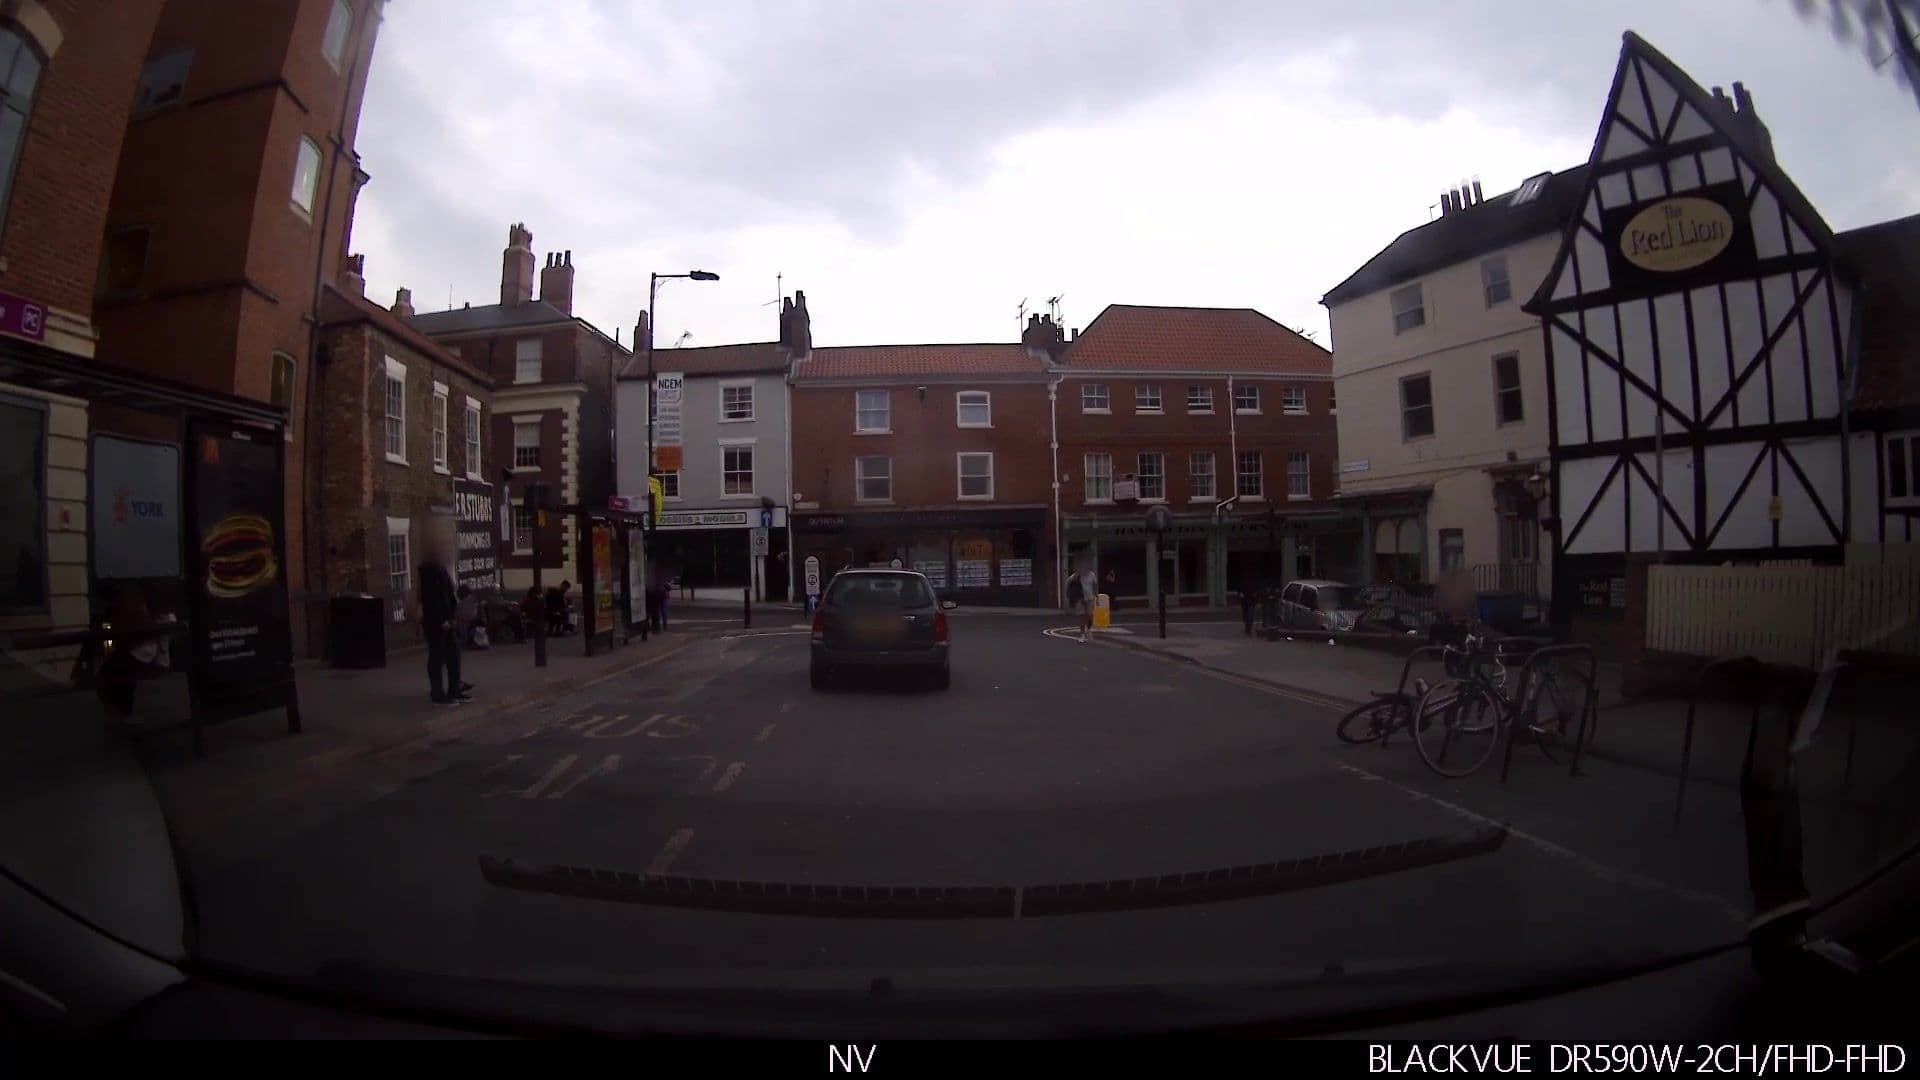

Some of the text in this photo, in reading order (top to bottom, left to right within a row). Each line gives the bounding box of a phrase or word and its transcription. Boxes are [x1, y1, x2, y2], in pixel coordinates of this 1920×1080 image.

[1631, 219, 1725, 256] Red Lion
[658, 378, 682, 390] NCEM
[131, 501, 165, 518] YORK
